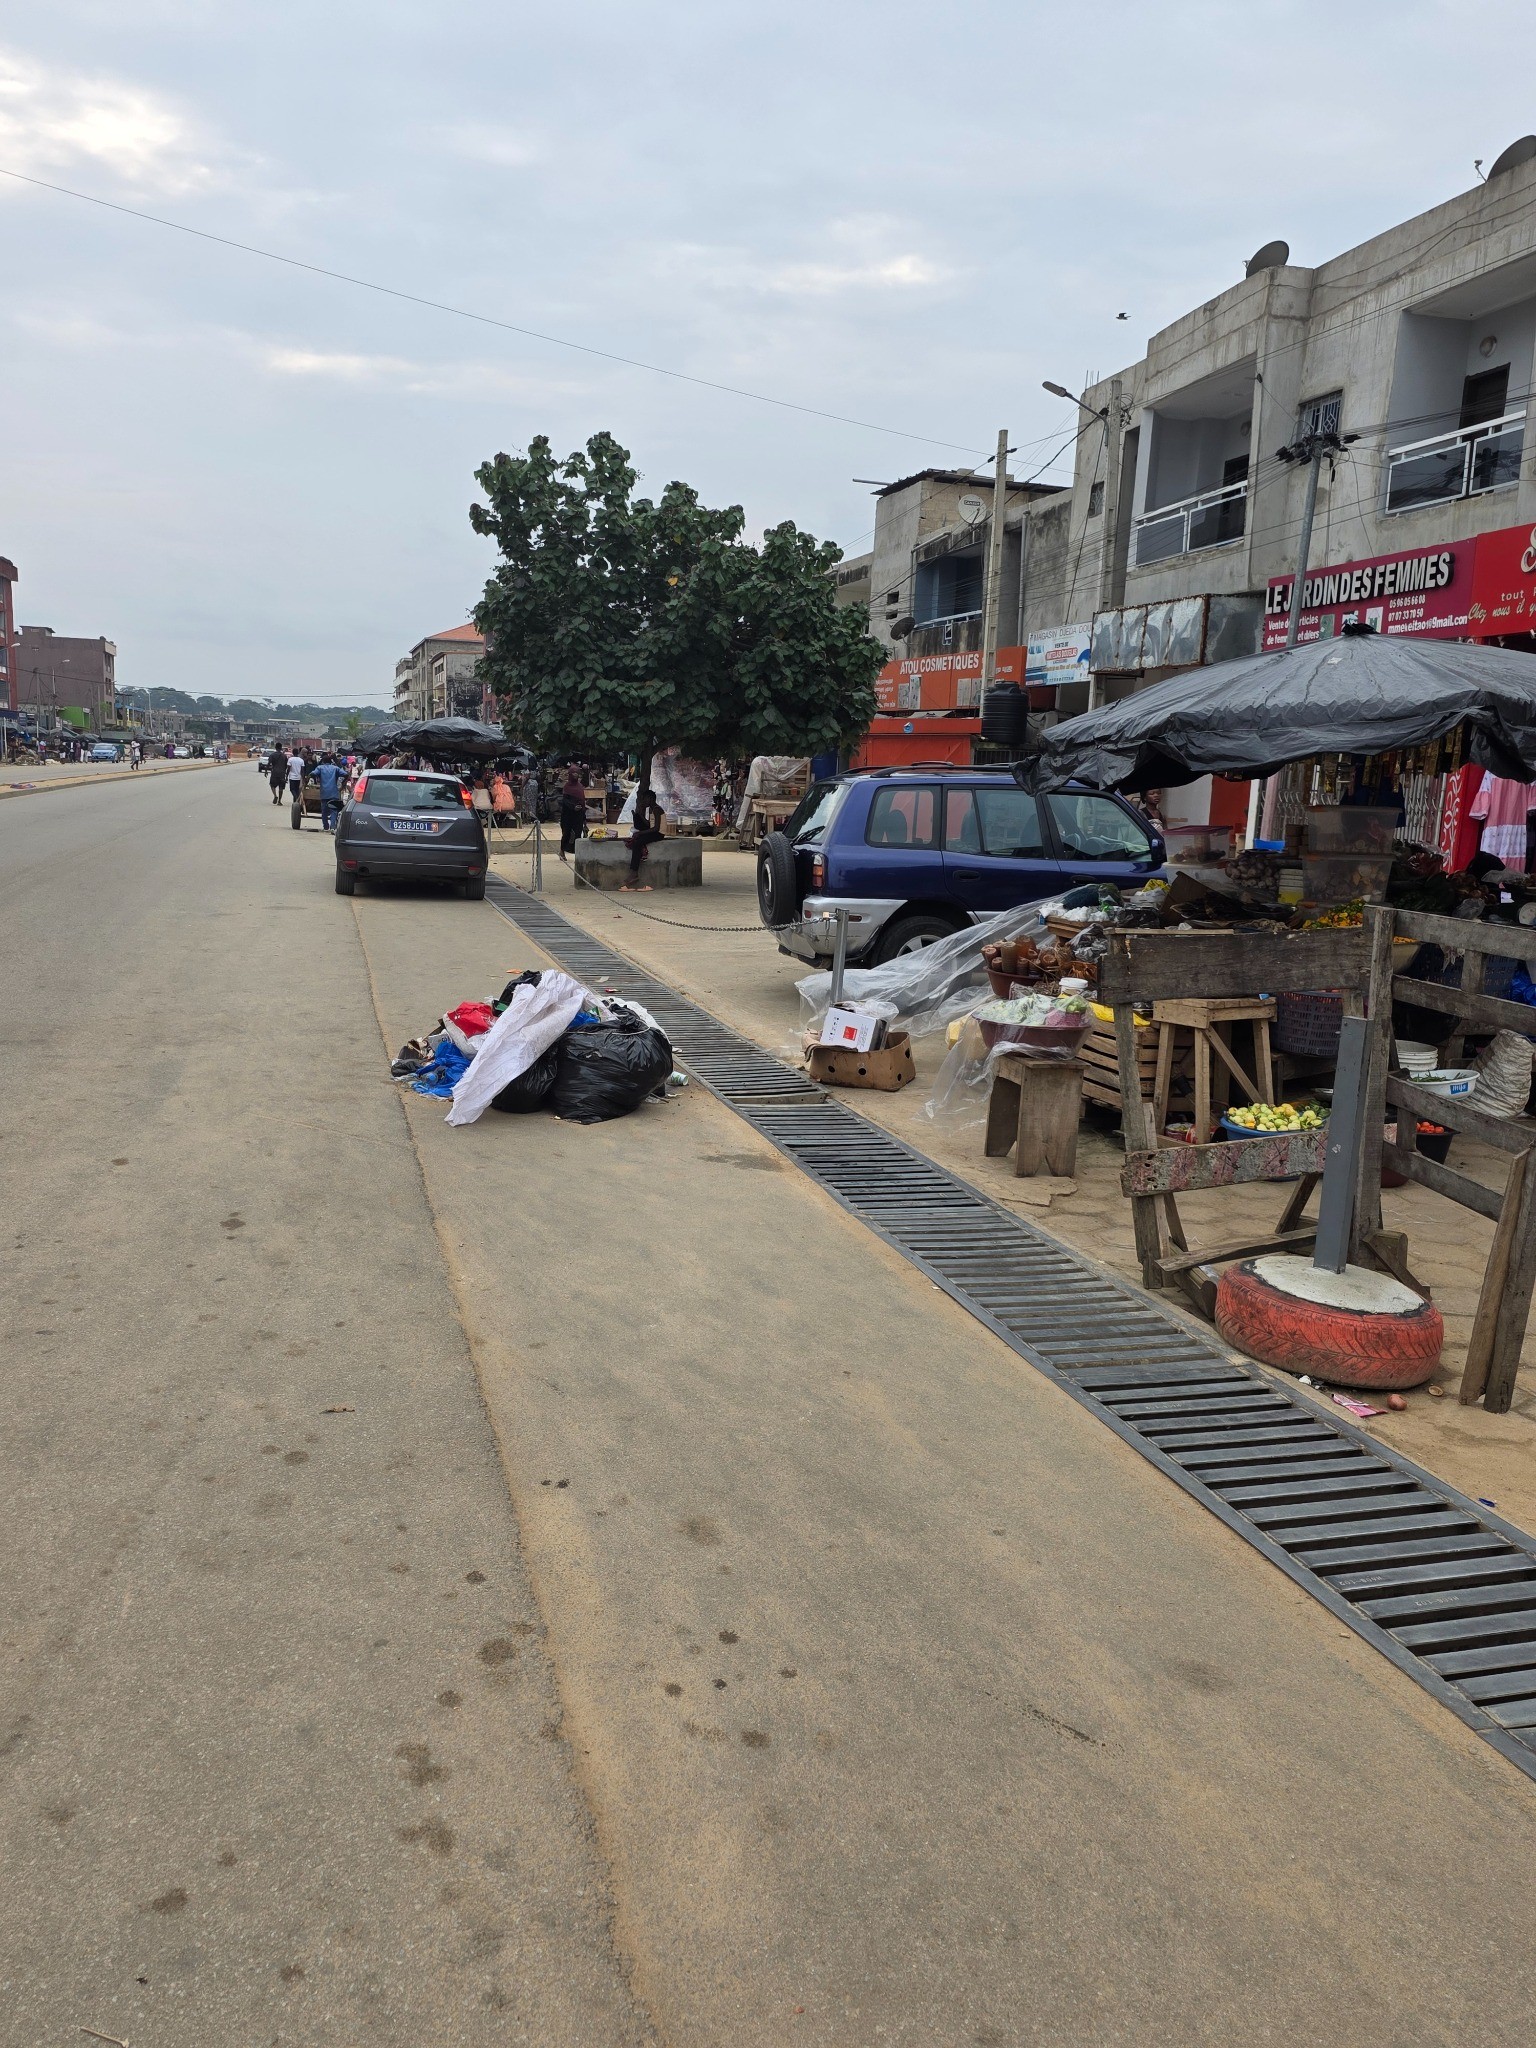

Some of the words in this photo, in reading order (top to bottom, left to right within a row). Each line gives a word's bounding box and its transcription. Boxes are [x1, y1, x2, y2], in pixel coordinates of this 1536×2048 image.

[1265, 585, 1283, 615] LE
[1283, 573, 1340, 612] JRDIN
[1339, 566, 1374, 603] DES
[1373, 551, 1452, 597] FEMMES
[1501, 590, 1524, 601] tout
[1468, 603, 1487, 624] Chez
[1492, 605, 1511, 617] nous
[1516, 598, 1526, 614] il
[1268, 619, 1285, 631] Vente
[1298, 614, 1319, 627] rticles
[1266, 635, 1274, 646] de
[1274, 633, 1289, 645] femm
[1297, 631, 1305, 642] et
[900, 659, 919, 675] ATOU
[920, 653, 980, 673] COSMETIQUES
